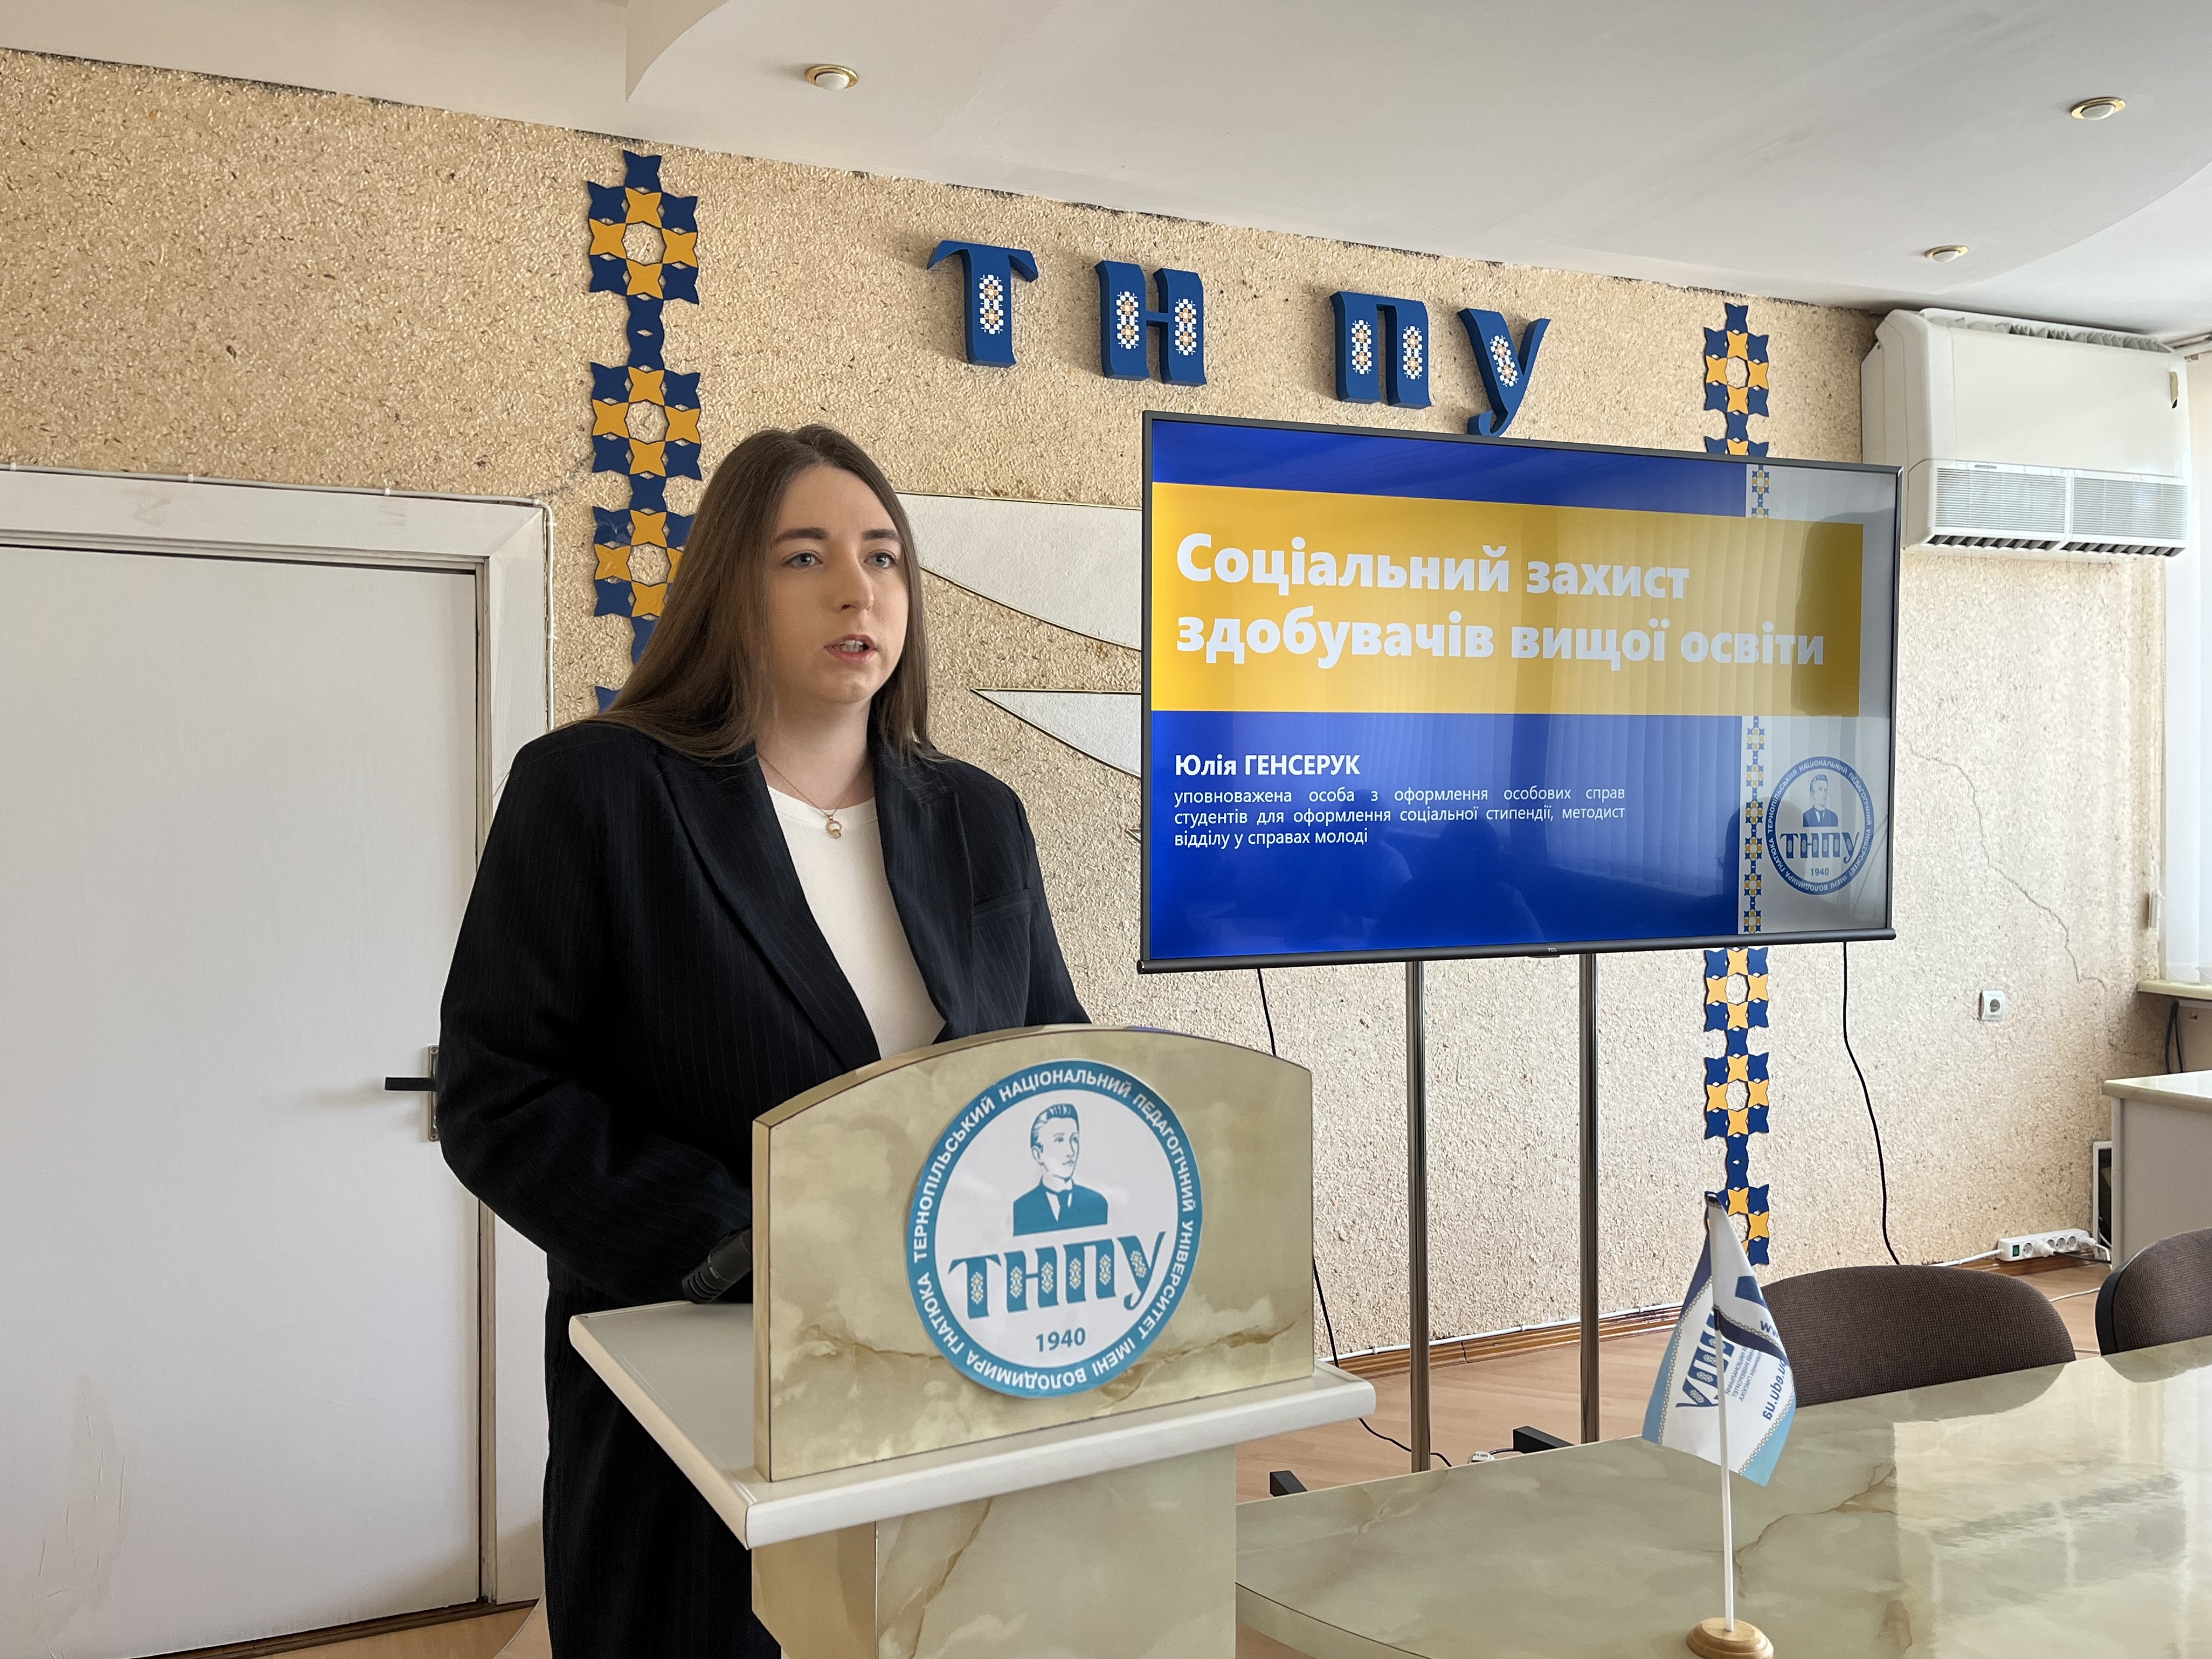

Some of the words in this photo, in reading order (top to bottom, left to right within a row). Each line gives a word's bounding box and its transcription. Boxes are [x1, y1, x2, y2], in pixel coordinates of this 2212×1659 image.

[1177, 533, 1509, 596] Соціальний
[1526, 561, 1690, 599] захист
[1177, 605, 1494, 669] здобувачів
[1511, 618, 1671, 671] вищої
[1680, 621, 1824, 665] освіти
[1175, 754, 1237, 776] Юлія
[1244, 754, 1361, 775] ГЕНСЕРУК
[1799, 760, 1848, 775] НАЦІОНАЛЬНИЙ
[1174, 790, 1292, 808] уповноважена
[1309, 787, 1355, 802] особа
[1370, 791, 1379, 802] з
[1394, 787, 1488, 805] оформлення
[1504, 785, 1571, 800] особових
[1585, 788, 1625, 803] справ
[1768, 769, 1797, 834] ТЕРНОПІЛЬСЬКИЙ
[1848, 772, 1872, 826] ПЕДАГОГІЧНИЙ
[1174, 809, 1248, 828] студентів
[1256, 811, 1284, 825] для
[1293, 809, 1391, 827] оформлення
[1400, 806, 1479, 823] соціальної
[1486, 805, 1554, 822] стипендії,
[1562, 807, 1625, 820] методист
[1175, 831, 1230, 849] відділу
[1234, 834, 1243, 849] у
[1248, 832, 1310, 848] справах
[1315, 828, 1368, 845] молоді
[1769, 837, 1786, 872] ГНАТЮКА
[1780, 832, 1860, 864] ТНПУ
[1848, 828, 1871, 877] УНІВЕРСИТЕТ
[1785, 871, 1828, 891] ВОЛОДИМИРА
[1810, 868, 1829, 876] 1940
[1830, 874, 1848, 889] ІМЕНІ
[998, 1069, 1131, 1103] НАЦІОНАЛЬНИЙ
[1132, 1093, 1197, 1213] ПЕДАГОГІЧНИЙ
[913, 1096, 996, 1263] ТЕРНОПІЛЬСЬКИЙ
[947, 1231, 1167, 1320] ТНПУ
[1137, 1220, 1193, 1340] УНІВЕРСИТЕТ
[917, 1272, 964, 1355] ГНАТЮКА
[1036, 1327, 1086, 1352] 1940
[1092, 1337, 1136, 1376] ІМЕНІ
[966, 1350, 1087, 1390] ВОЛОДИМИРА
